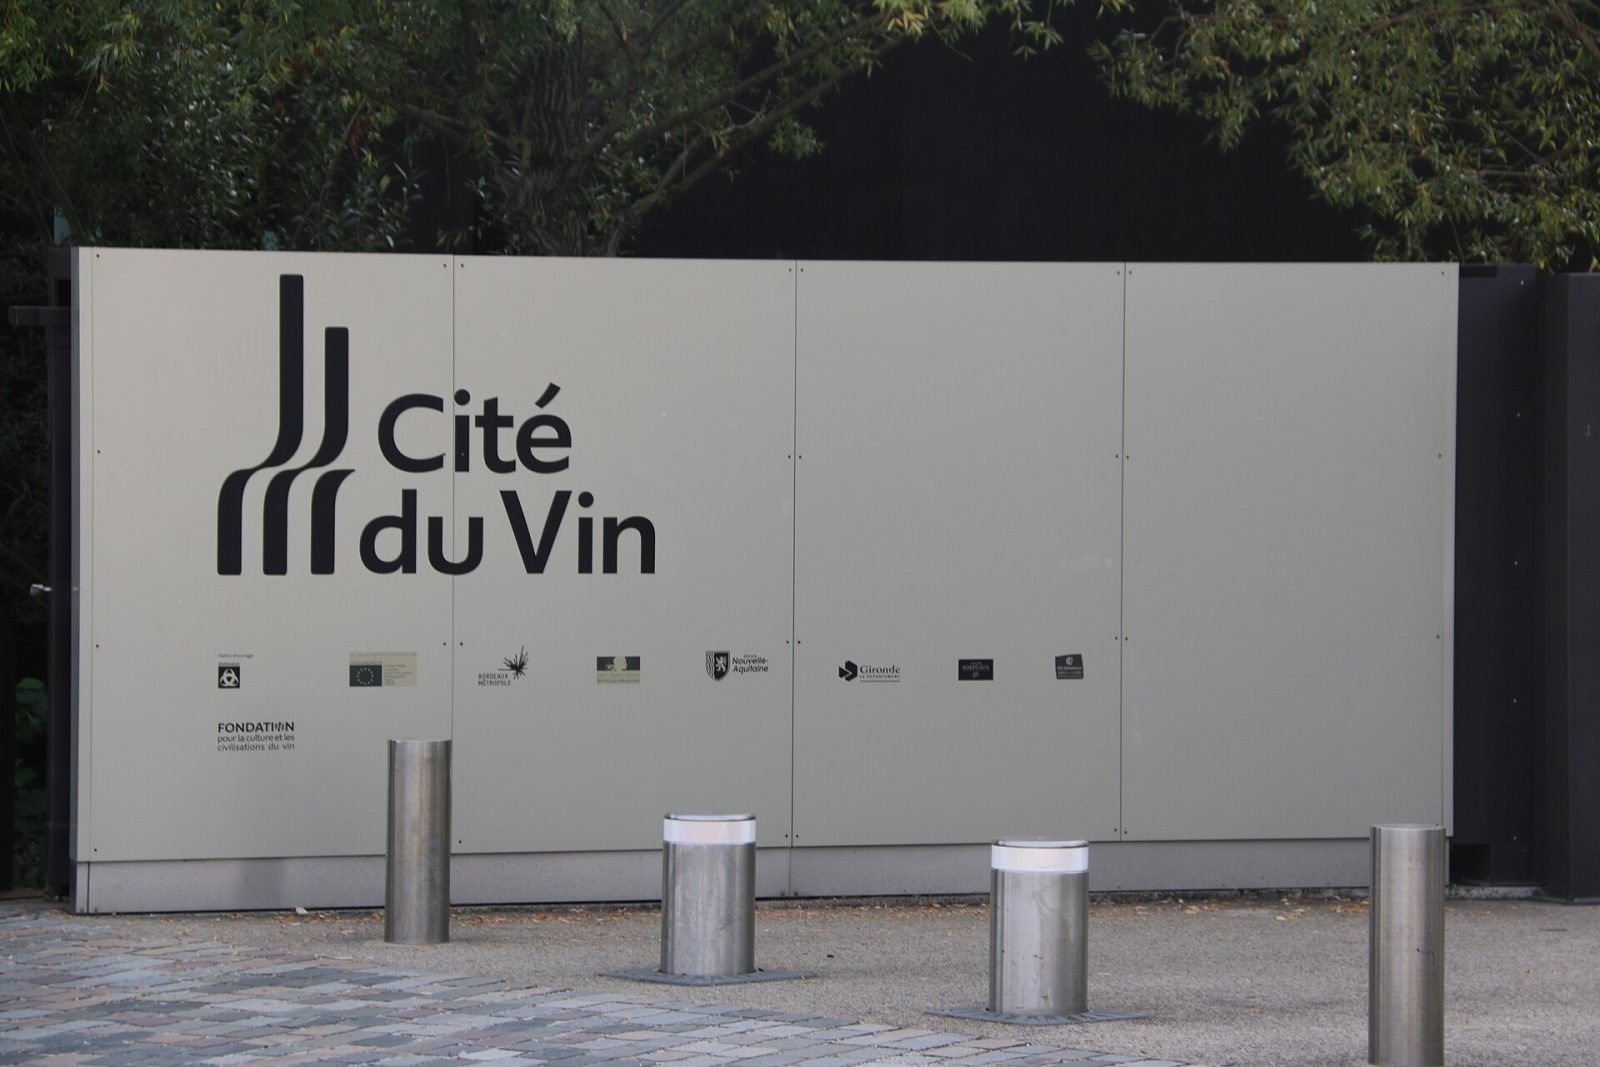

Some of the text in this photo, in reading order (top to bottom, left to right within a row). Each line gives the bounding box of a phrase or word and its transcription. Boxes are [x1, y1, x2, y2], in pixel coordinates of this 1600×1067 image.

[378, 382, 572, 474] Cité
[359, 489, 656, 575] du Vin
[732, 665, 769, 675] Aquitaine
[860, 665, 900, 674] Gironde
[217, 735, 236, 744] pour
[246, 733, 274, 742] culture
[275, 734, 282, 742] et
[283, 733, 295, 742] les
[217, 741, 295, 752] civilisations du vin
